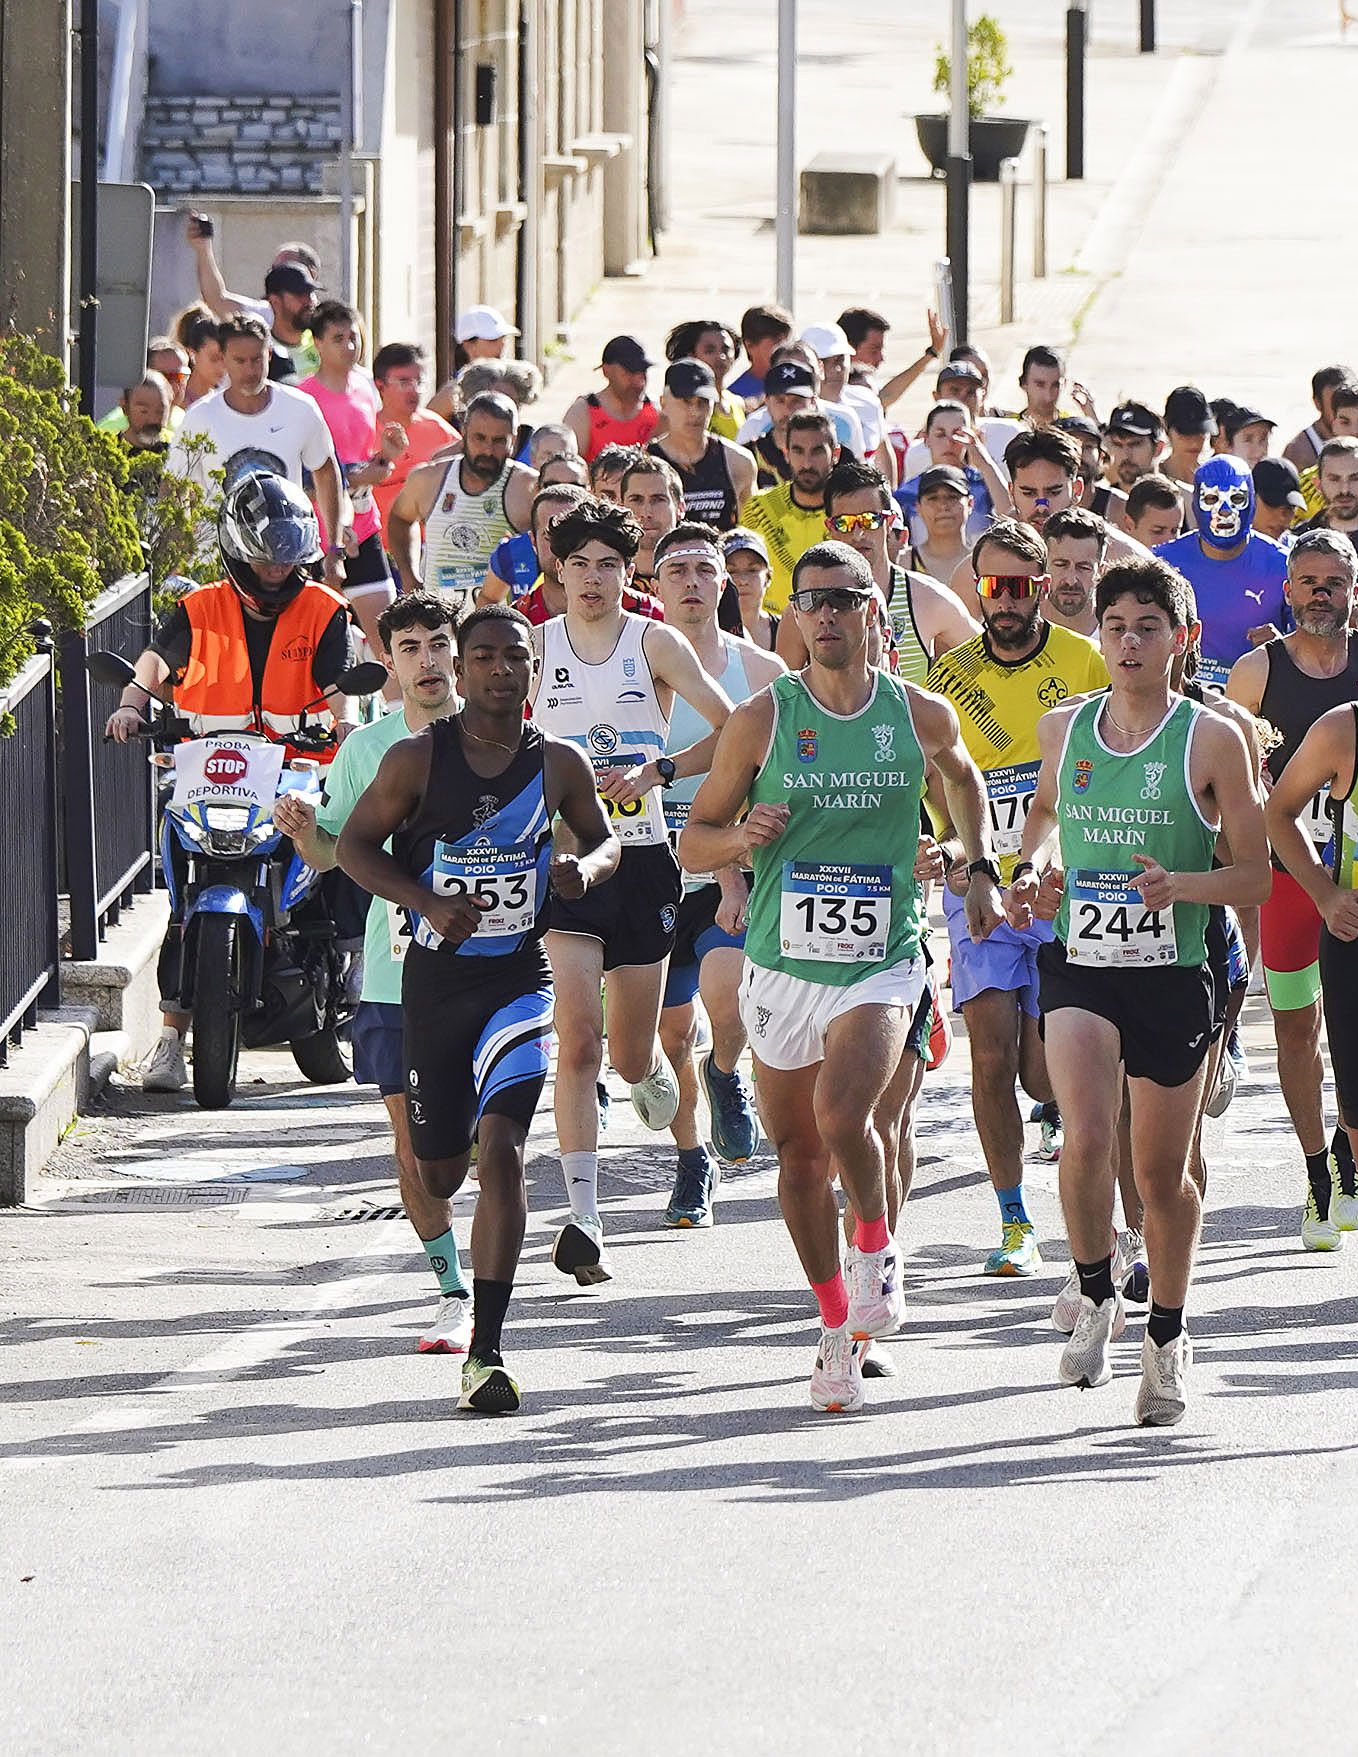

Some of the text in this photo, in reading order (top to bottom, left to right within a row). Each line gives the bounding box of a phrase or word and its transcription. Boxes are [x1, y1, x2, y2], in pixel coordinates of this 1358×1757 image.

[1197, 672, 1214, 680] OIO
[205, 740, 251, 750] PROBA
[206, 759, 247, 774] STOP
[989, 768, 1015, 779] XXXVII
[783, 771, 911, 788] SAN MIGUEL
[187, 785, 259, 801] DEPORTIVA
[990, 784, 1017, 796] POIO
[812, 790, 883, 809] MARÍN
[664, 810, 688, 818] RATÓN
[1065, 803, 1175, 826] SAN MIGUEL
[1082, 826, 1146, 846] MARÍN
[466, 847, 498, 856] XXXVII
[441, 853, 480, 865] MARATÓN
[490, 851, 527, 863] FÁTIMA
[464, 865, 496, 874] POIO
[819, 865, 851, 873] XXXVII
[791, 872, 832, 882] MARATÓN
[843, 874, 881, 884] FÁTIMA
[1098, 873, 1129, 881] XXXVII
[816, 884, 848, 893] POIO
[1076, 880, 1112, 890] MARATÓN
[1098, 892, 1128, 901] POIO
[795, 897, 878, 937] 135
[1078, 903, 1166, 942] 244
